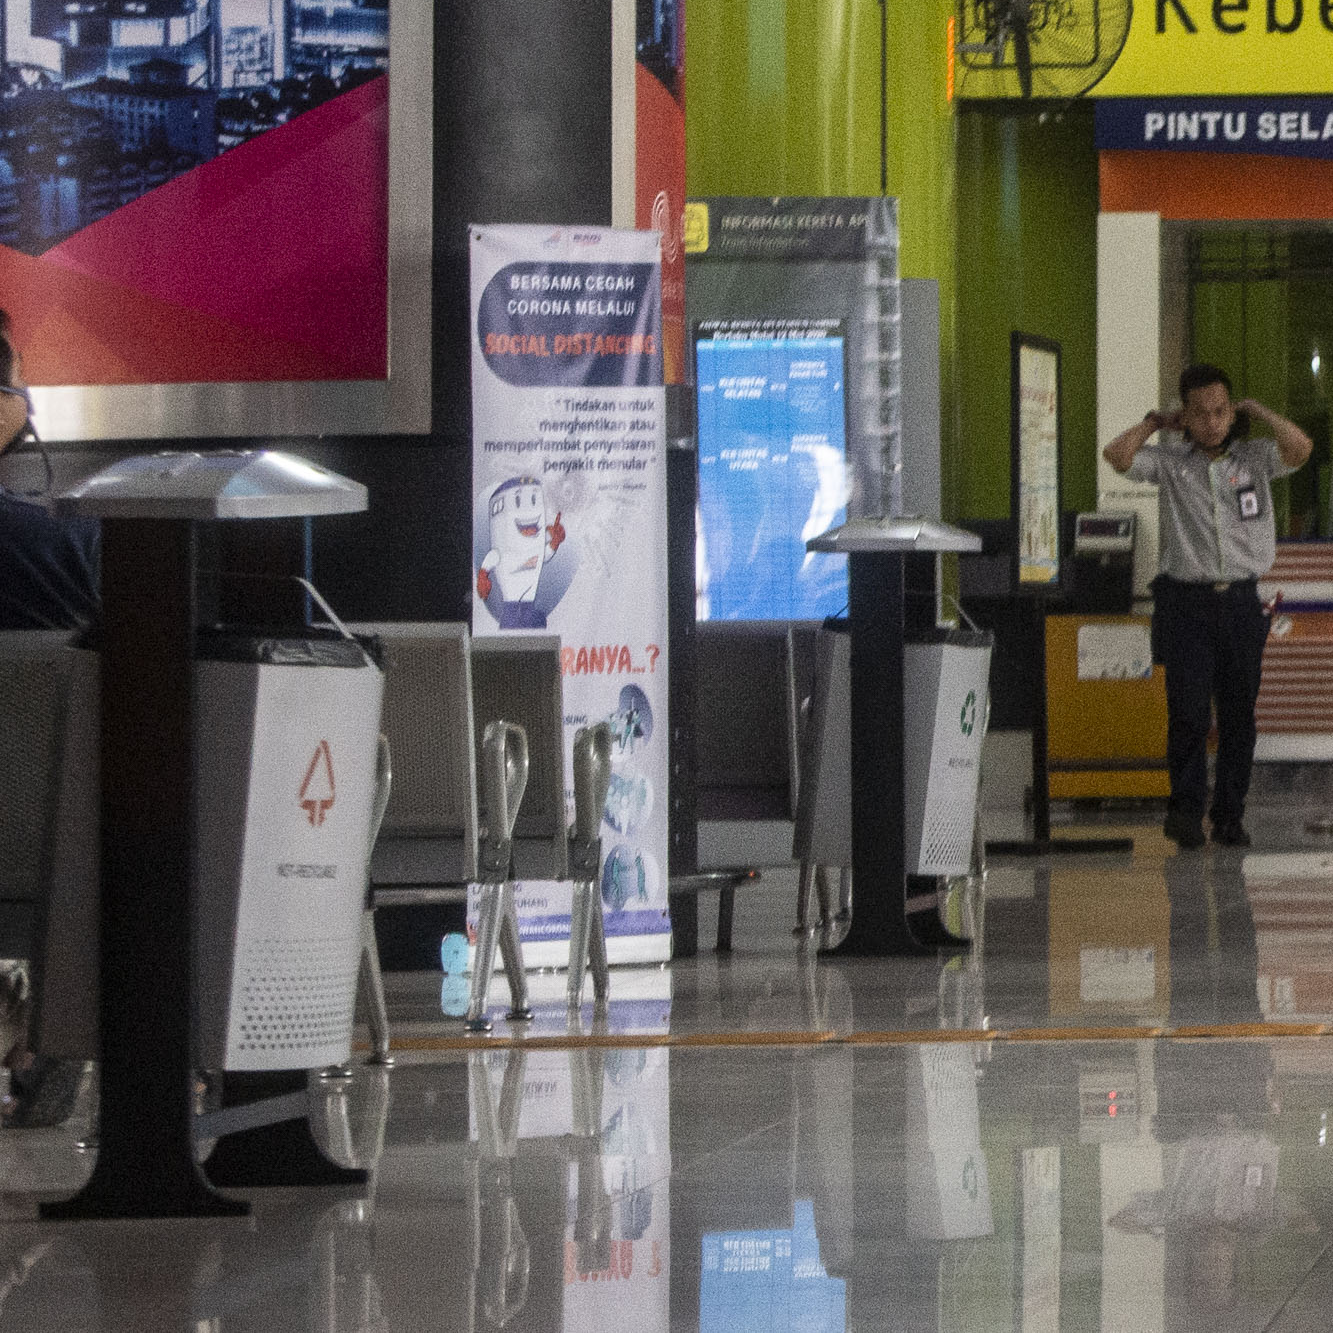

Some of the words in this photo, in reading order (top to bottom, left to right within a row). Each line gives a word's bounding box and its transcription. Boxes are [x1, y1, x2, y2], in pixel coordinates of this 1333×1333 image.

[1144, 110, 1248, 142] PINTU
[510, 275, 581, 291] BERSAMA
[585, 275, 635, 290] CEGAH
[507, 299, 570, 316] CORONA
[575, 299, 635, 315] MELALUI
[484, 333, 549, 356] SOCIAL
